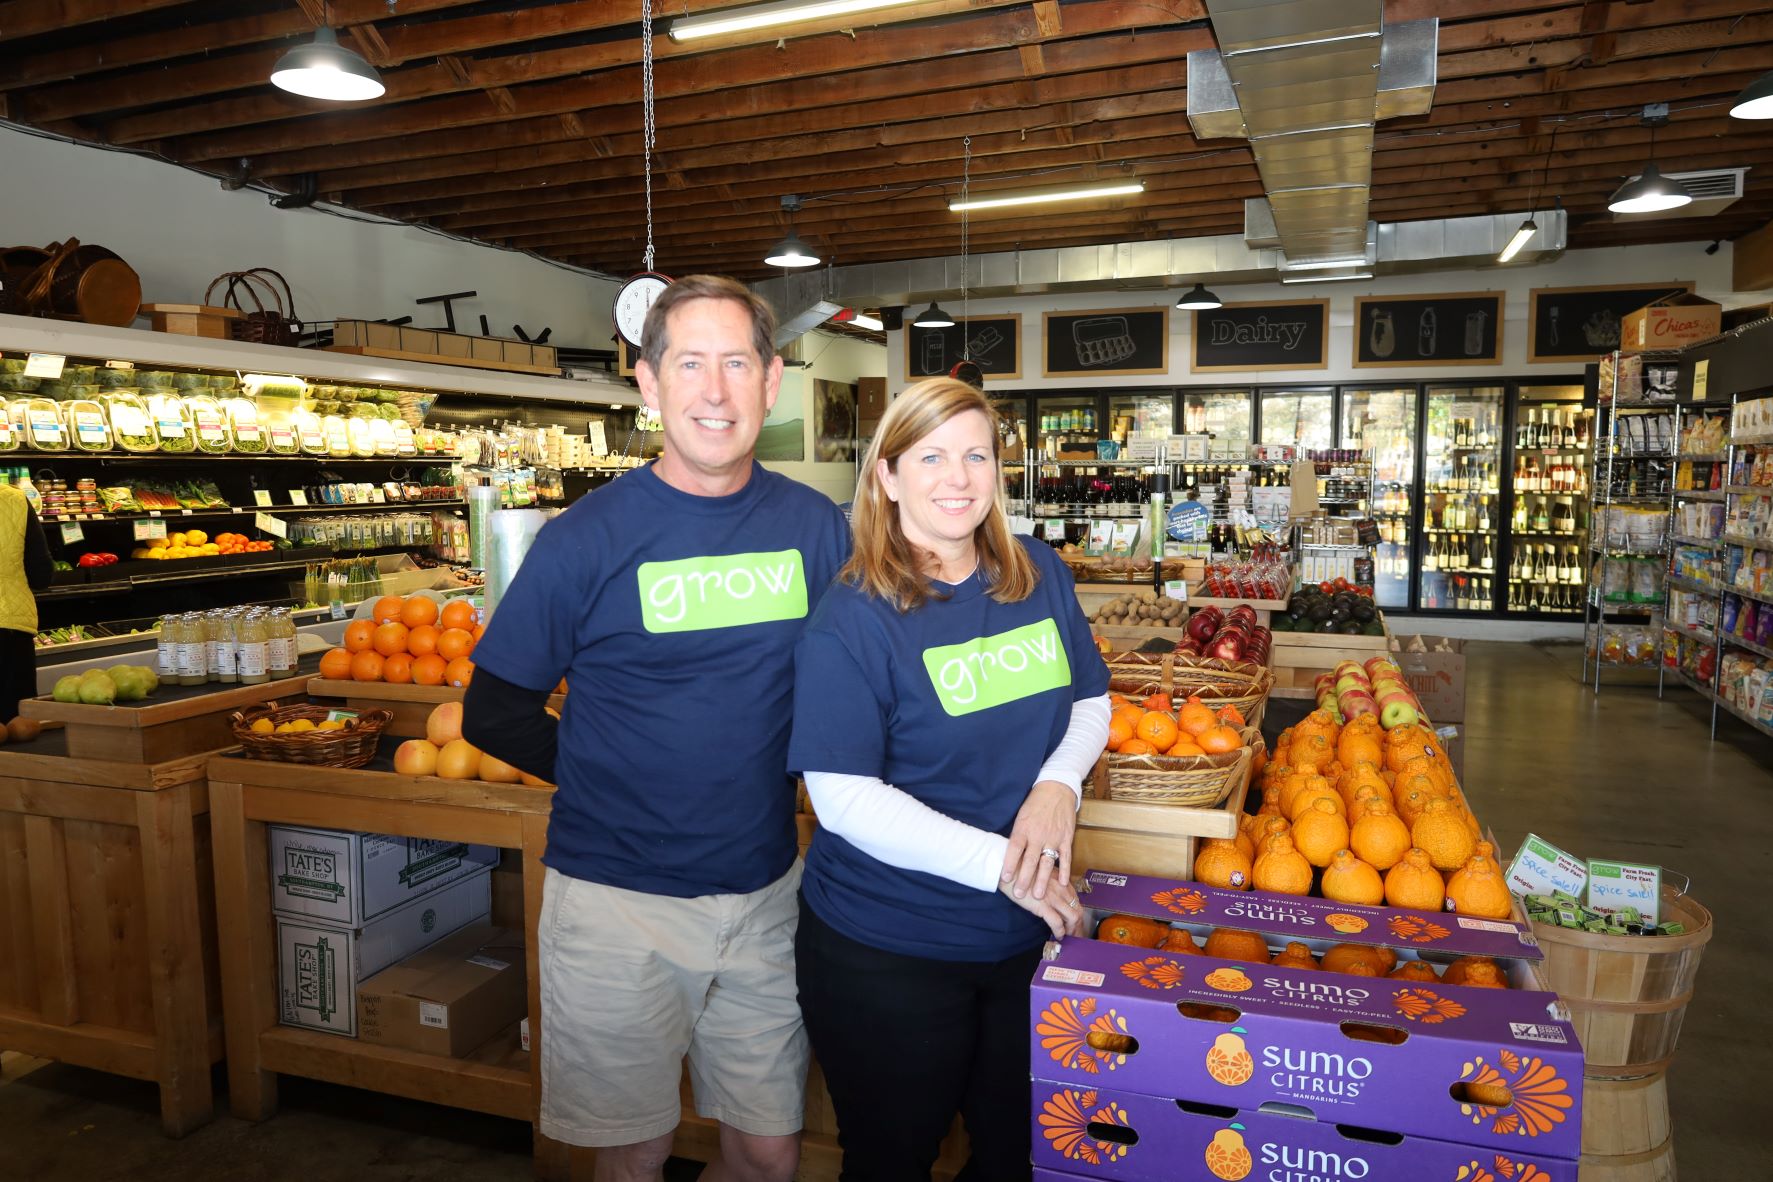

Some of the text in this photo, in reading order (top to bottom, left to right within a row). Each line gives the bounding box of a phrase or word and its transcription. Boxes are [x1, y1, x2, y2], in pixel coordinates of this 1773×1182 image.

[1211, 315, 1307, 350] Dairy
[1654, 318, 1700, 337] Chicas
[649, 562, 796, 624] grow
[939, 631, 1057, 706] grow
[288, 852, 333, 874] TATE'S
[1558, 856, 1573, 867] Farm
[1558, 862, 1570, 873] City
[293, 868, 328, 880] BAKE SHOP
[1622, 867, 1657, 877] Farm Fresh.
[1625, 874, 1638, 882] City
[1513, 875, 1535, 891] Origin:
[299, 948, 313, 1004] TATE'S
[1188, 989, 1238, 999] INCREDIBLY
[1279, 1000, 1320, 1010] SEEDLESS
[1332, 1007, 1393, 1019] EASY-TO-PEEL
[1293, 1092, 1339, 1104] MANDARINS
